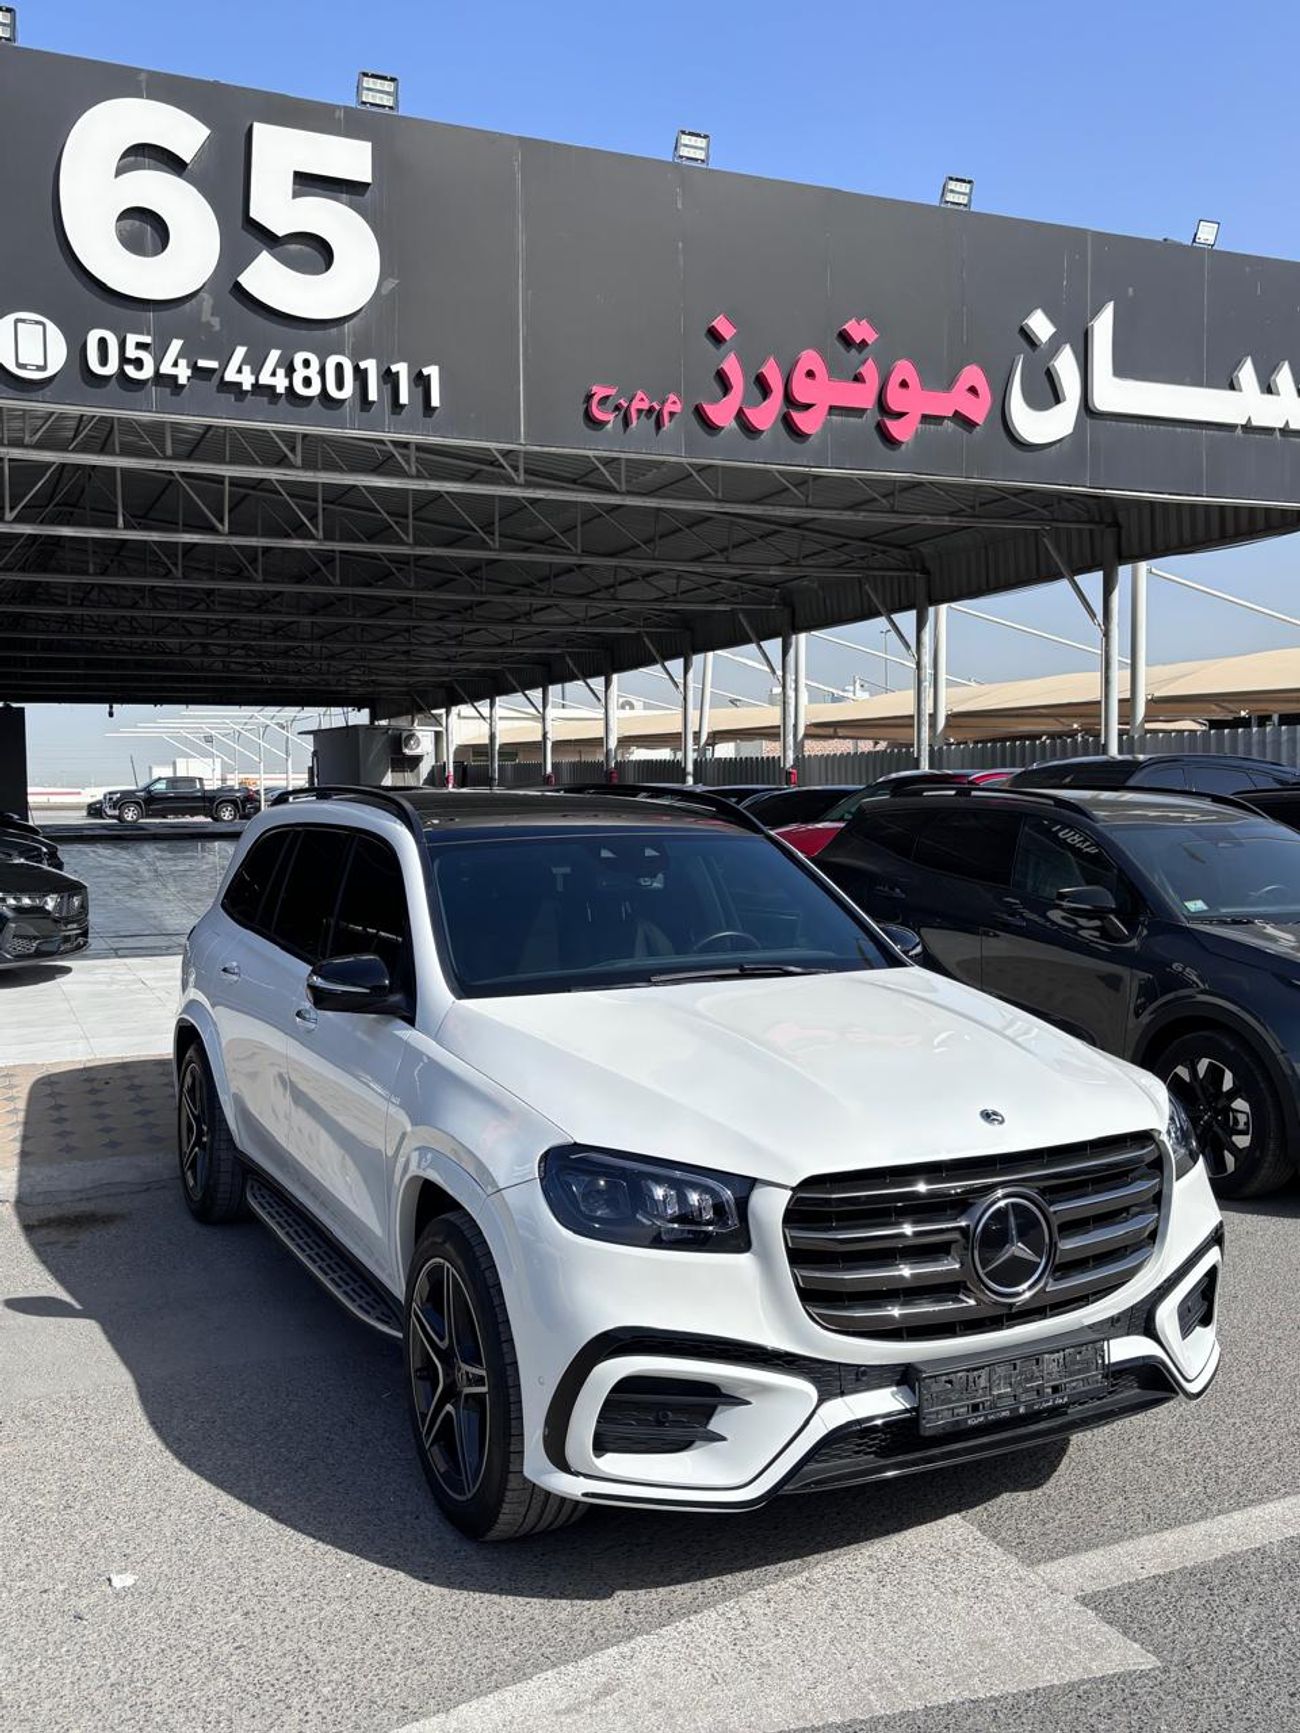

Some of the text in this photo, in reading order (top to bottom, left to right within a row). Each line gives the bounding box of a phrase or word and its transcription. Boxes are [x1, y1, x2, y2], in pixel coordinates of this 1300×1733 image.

[59, 97, 381, 320] 65
[85, 328, 440, 407] 054-4480111
[698, 313, 992, 443] موتورز
